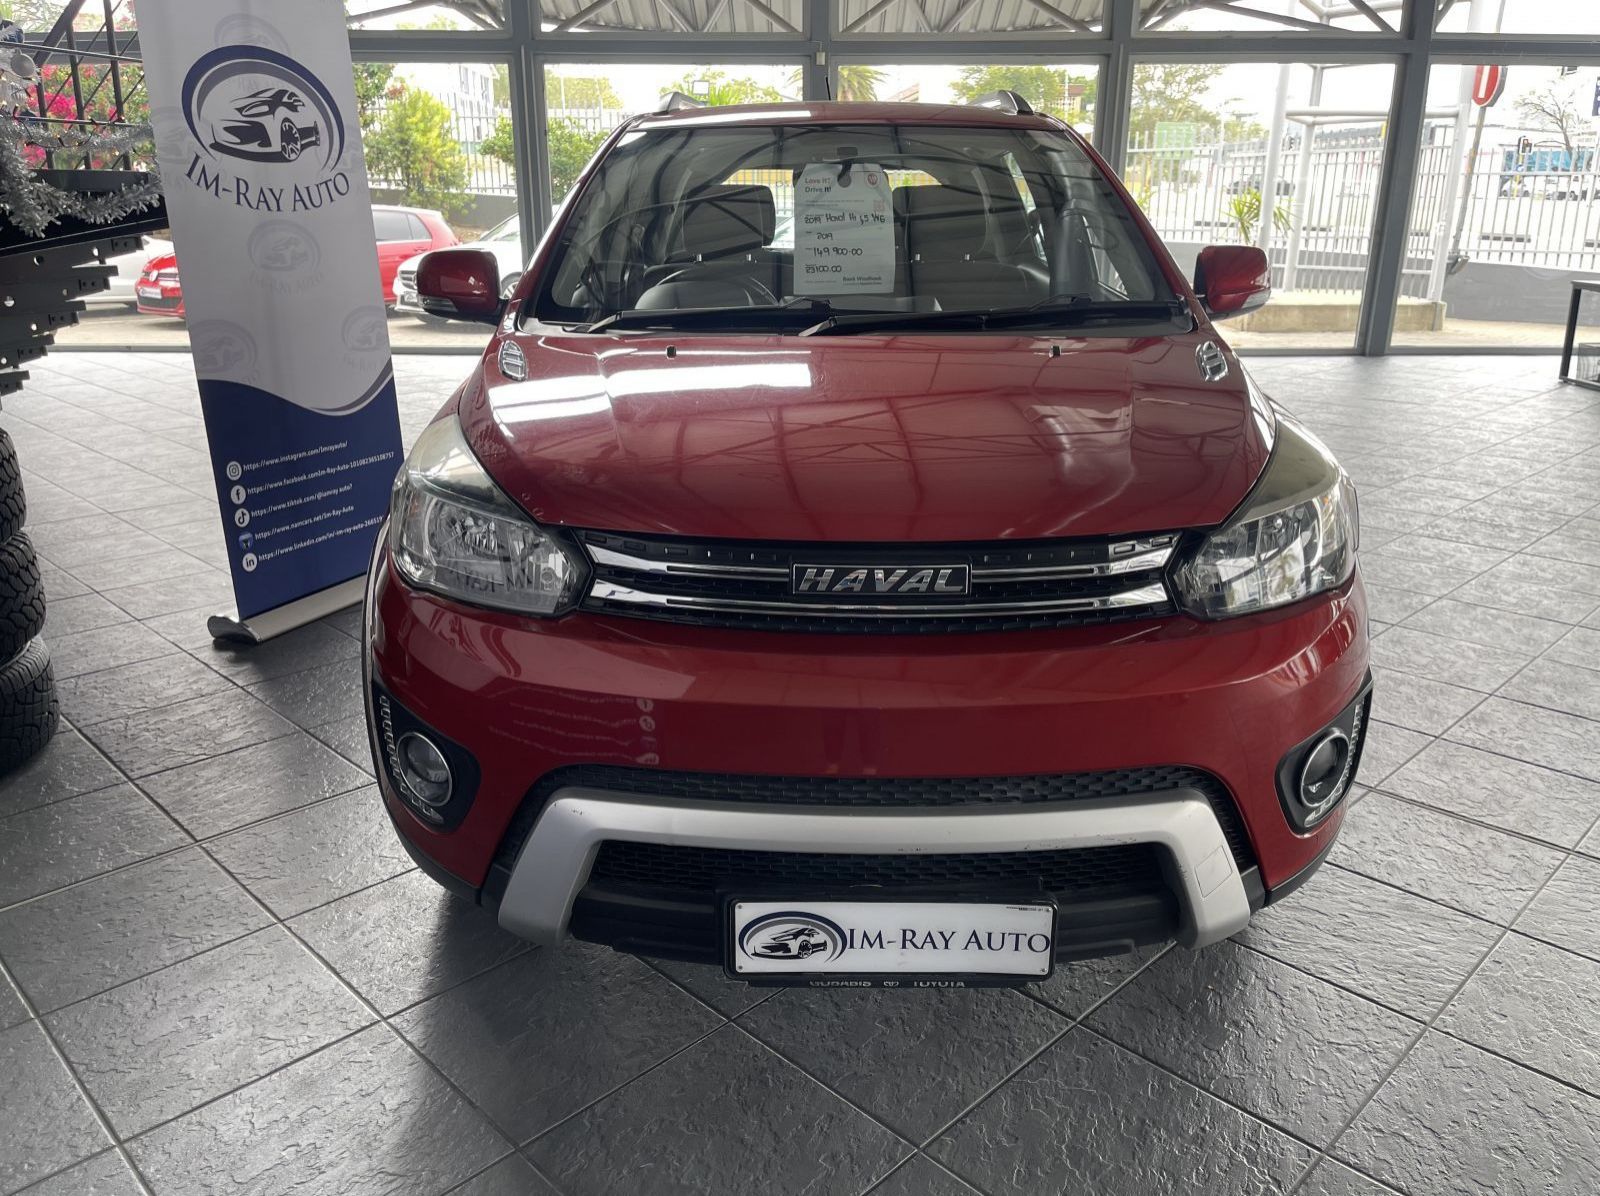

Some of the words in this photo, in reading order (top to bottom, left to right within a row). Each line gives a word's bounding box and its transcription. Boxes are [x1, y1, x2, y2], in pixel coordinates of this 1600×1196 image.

[184, 152, 284, 212] IM-RAY
[291, 171, 350, 212] AUTO
[816, 232, 833, 240] 2019
[798, 568, 963, 592] HAVAL
[847, 928, 957, 950] IM-RAY
[963, 930, 1051, 953] AUTO
